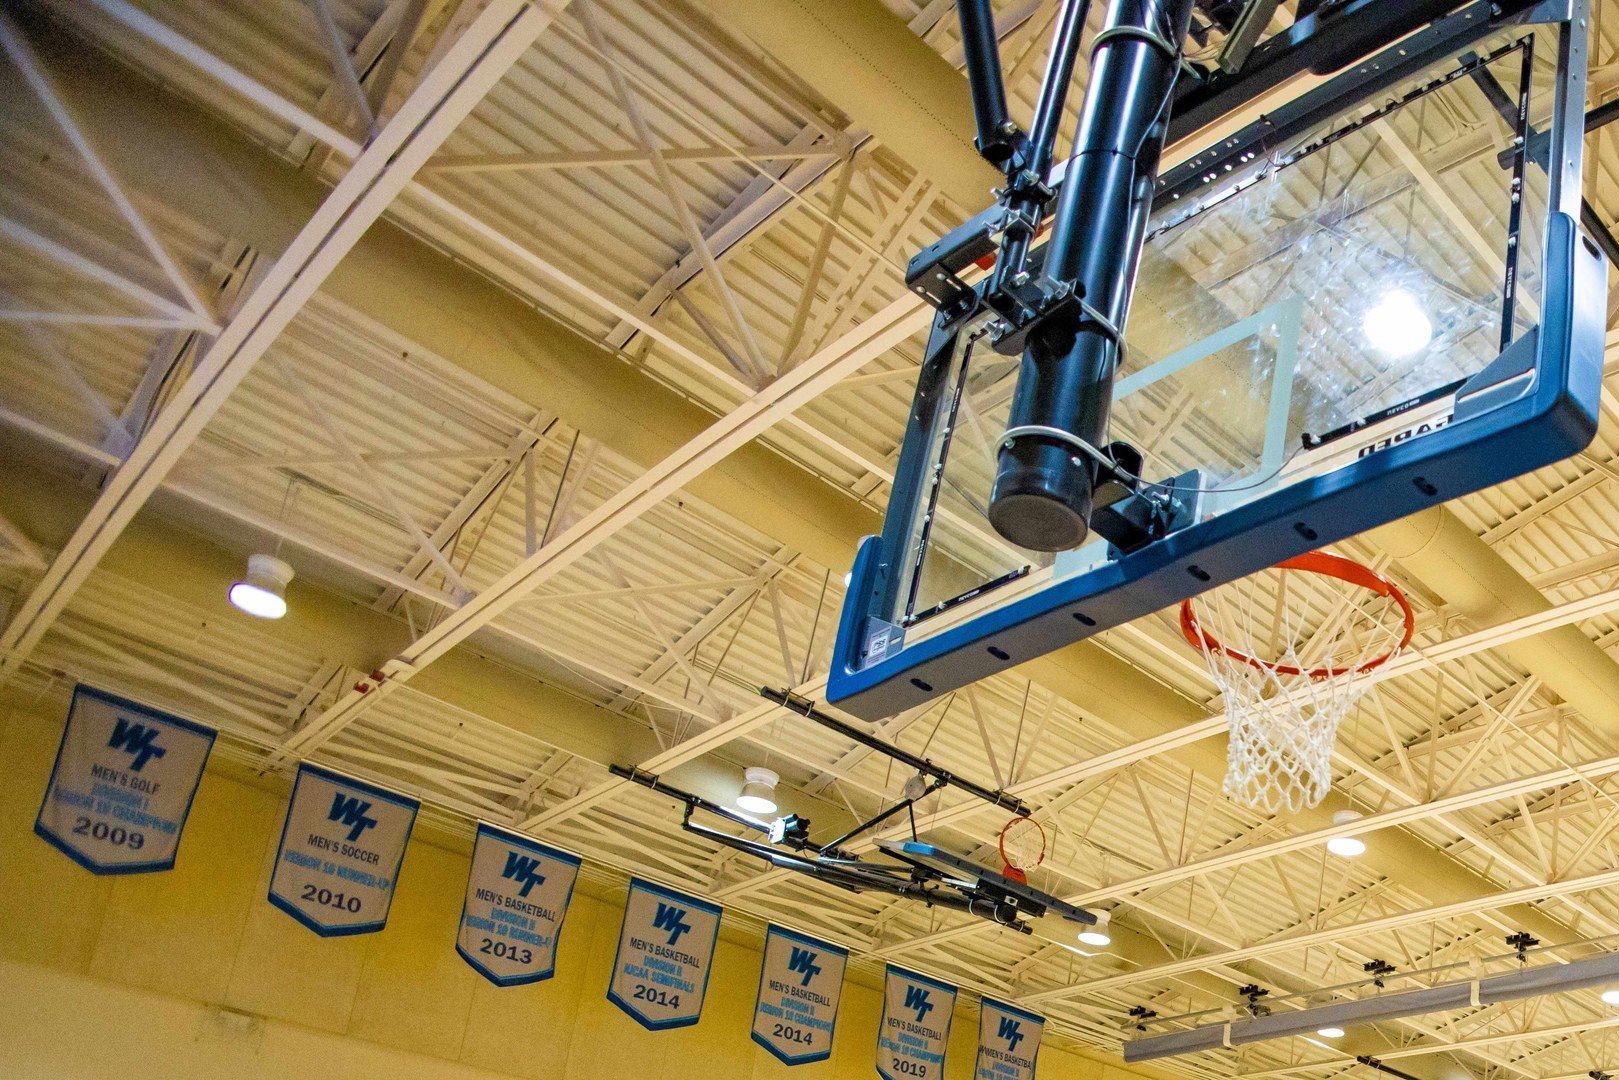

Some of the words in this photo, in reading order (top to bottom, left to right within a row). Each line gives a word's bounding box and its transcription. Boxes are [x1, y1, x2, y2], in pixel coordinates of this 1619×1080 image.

[108, 717, 166, 772] WT
[91, 764, 128, 787] MEN'S
[130, 777, 161, 795] GOLF
[328, 792, 378, 842] WT
[73, 816, 145, 850] 2009
[307, 834, 340, 854] MEN'S
[340, 844, 381, 865] SOCCER
[502, 851, 546, 898] WT
[301, 884, 362, 913] 2010
[475, 888, 503, 906] MEN'S
[504, 897, 556, 922] BASKETBALL
[652, 902, 693, 947] WT
[480, 938, 532, 965] 2013
[629, 937, 654, 954] MEN'S
[655, 945, 700, 969] BASKETBALL
[787, 946, 822, 987] WT
[633, 984, 680, 1010] 2014
[769, 980, 790, 994] MEN'S
[790, 986, 831, 1007] BASKETBALL
[904, 985, 934, 1022] WT
[773, 1023, 813, 1046] 2014
[906, 1022, 942, 1042] BASKETBALL
[997, 1015, 1025, 1053] WT
[893, 1058, 927, 1078] 2019
[978, 1045, 1004, 1061] WMEN'S
[1004, 1053, 1032, 1070] BASKETBA
